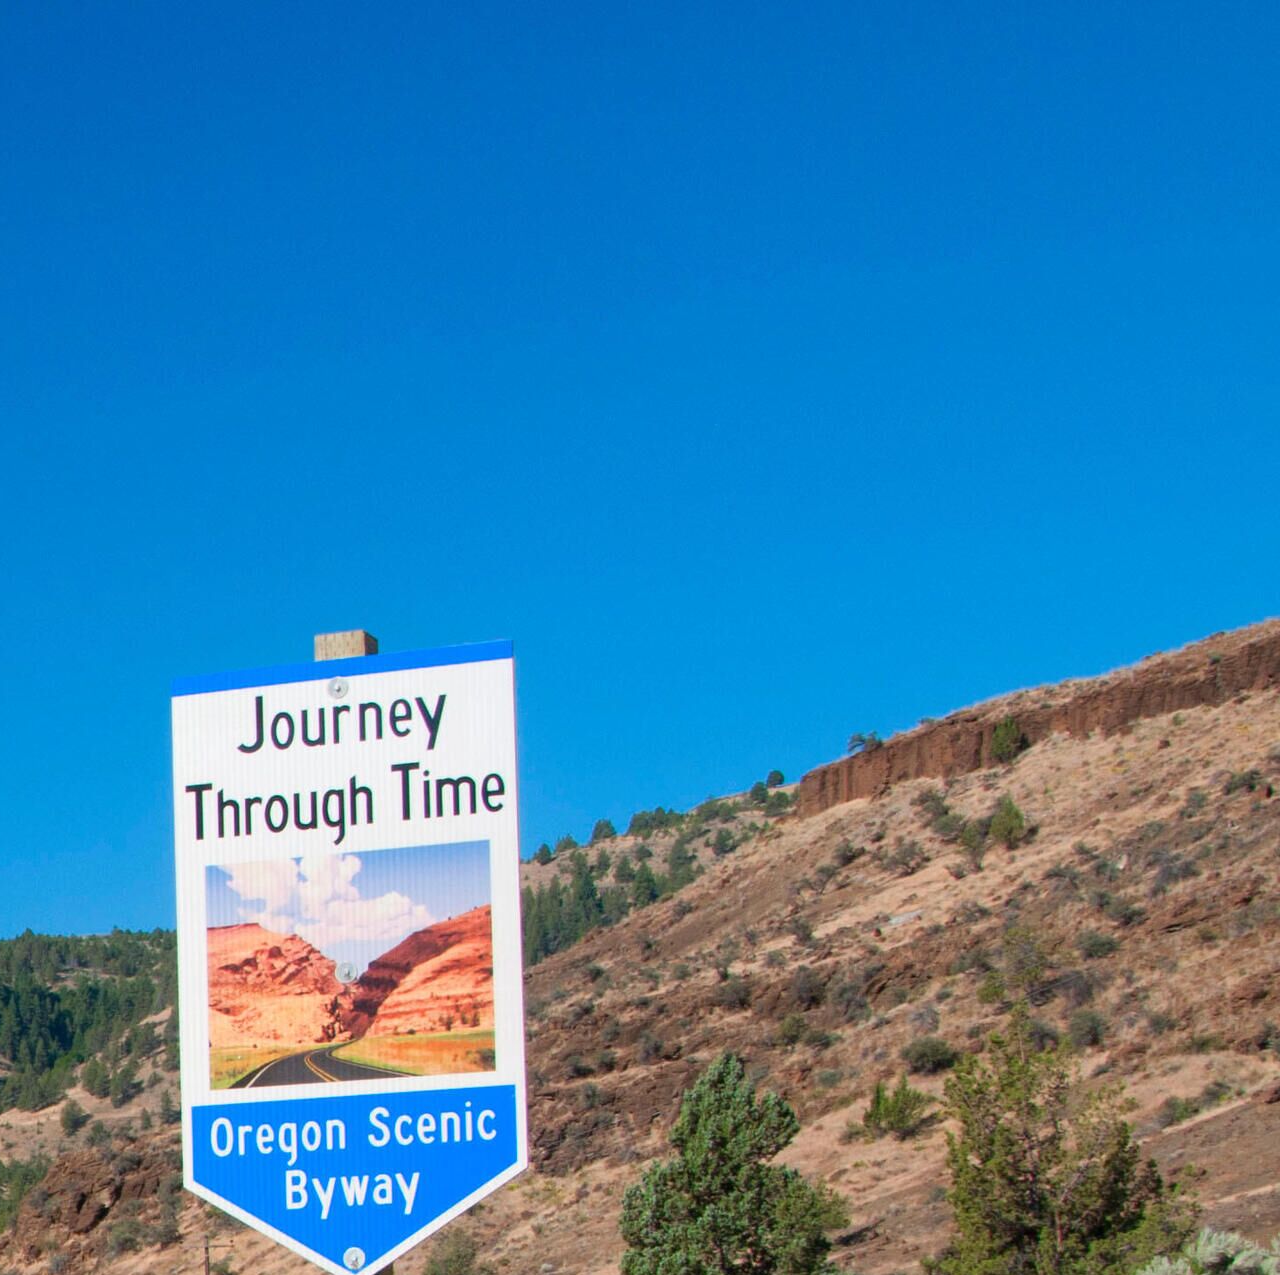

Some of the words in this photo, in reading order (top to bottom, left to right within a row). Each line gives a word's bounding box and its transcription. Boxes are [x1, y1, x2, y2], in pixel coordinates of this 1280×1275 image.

[237, 694, 447, 754] Journey
[185, 775, 374, 846] Through
[391, 762, 506, 821] Time
[210, 1116, 347, 1166] Oregon
[367, 1101, 498, 1148] Scenic
[284, 1169, 420, 1220] Byway
